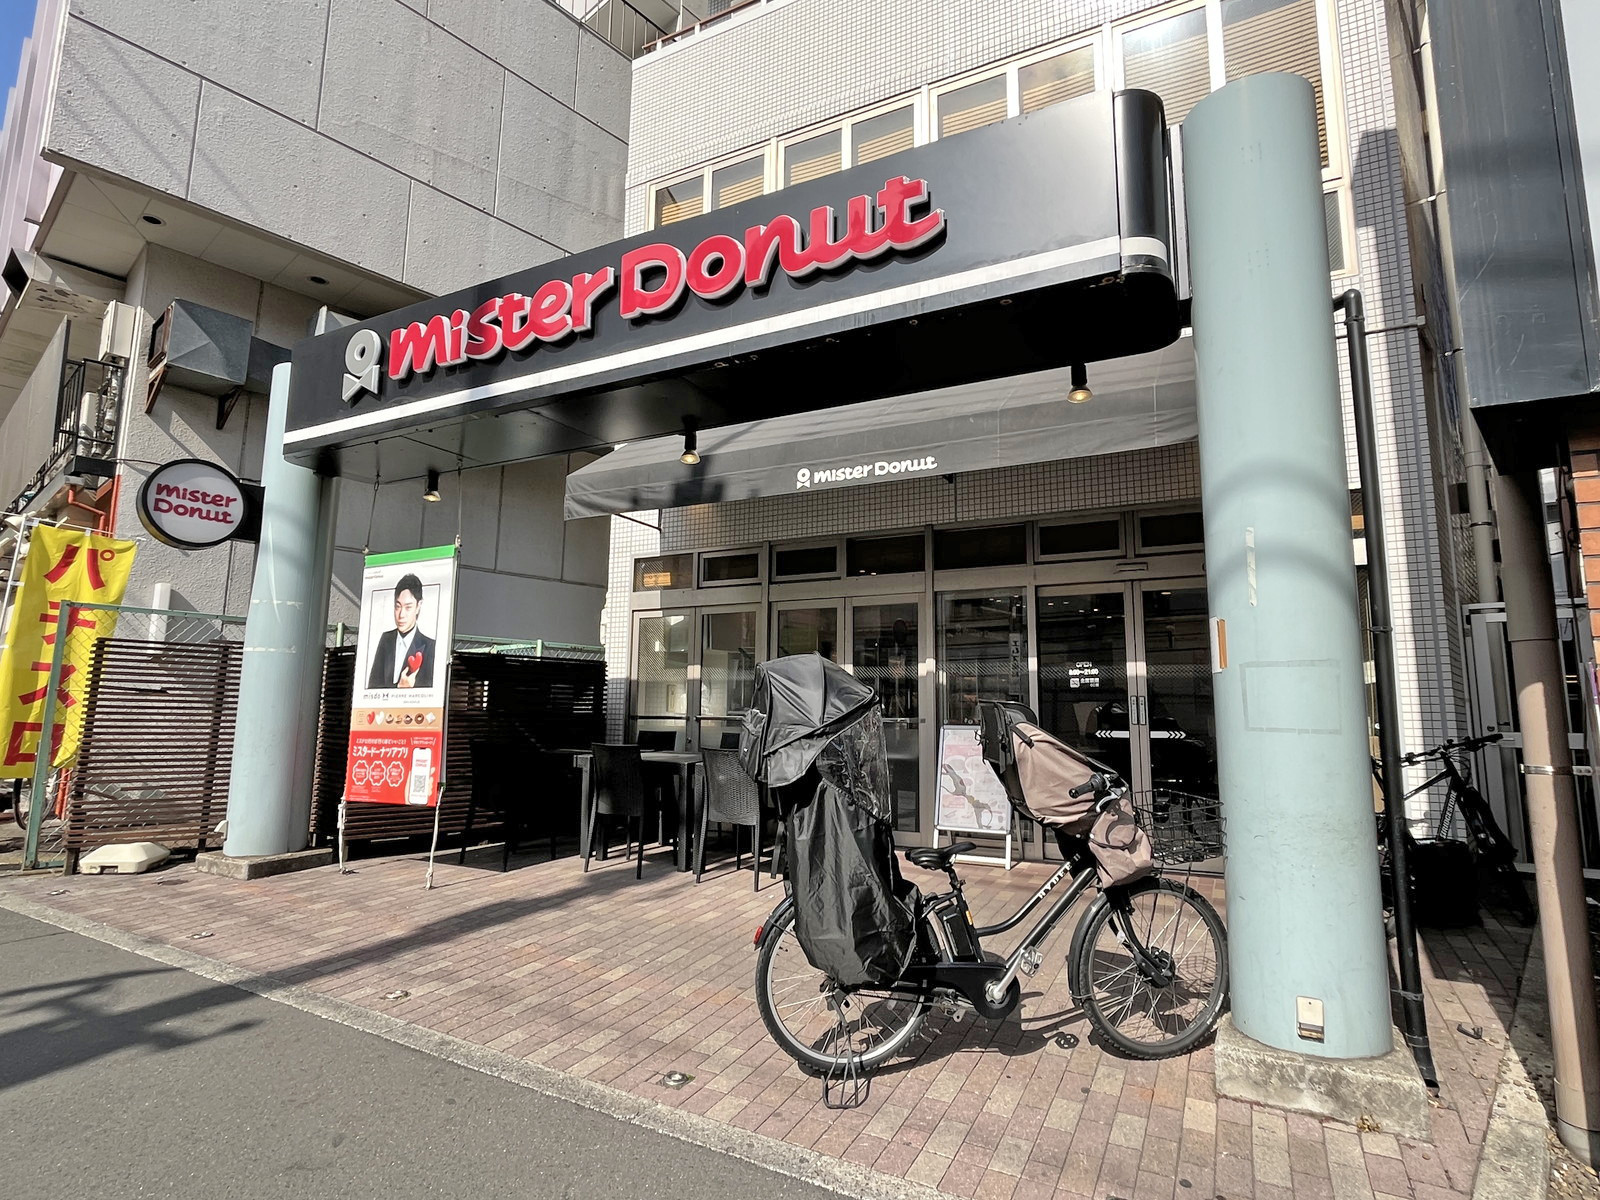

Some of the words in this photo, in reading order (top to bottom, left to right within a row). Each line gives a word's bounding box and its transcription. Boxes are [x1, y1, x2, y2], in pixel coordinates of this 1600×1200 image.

[389, 266, 615, 380] mister
[620, 175, 946, 319] Donut
[813, 464, 873, 484] mister
[874, 456, 938, 476] Donut
[155, 483, 237, 508] mister
[153, 498, 234, 524] Donut
[4, 543, 116, 766] パチスロ
